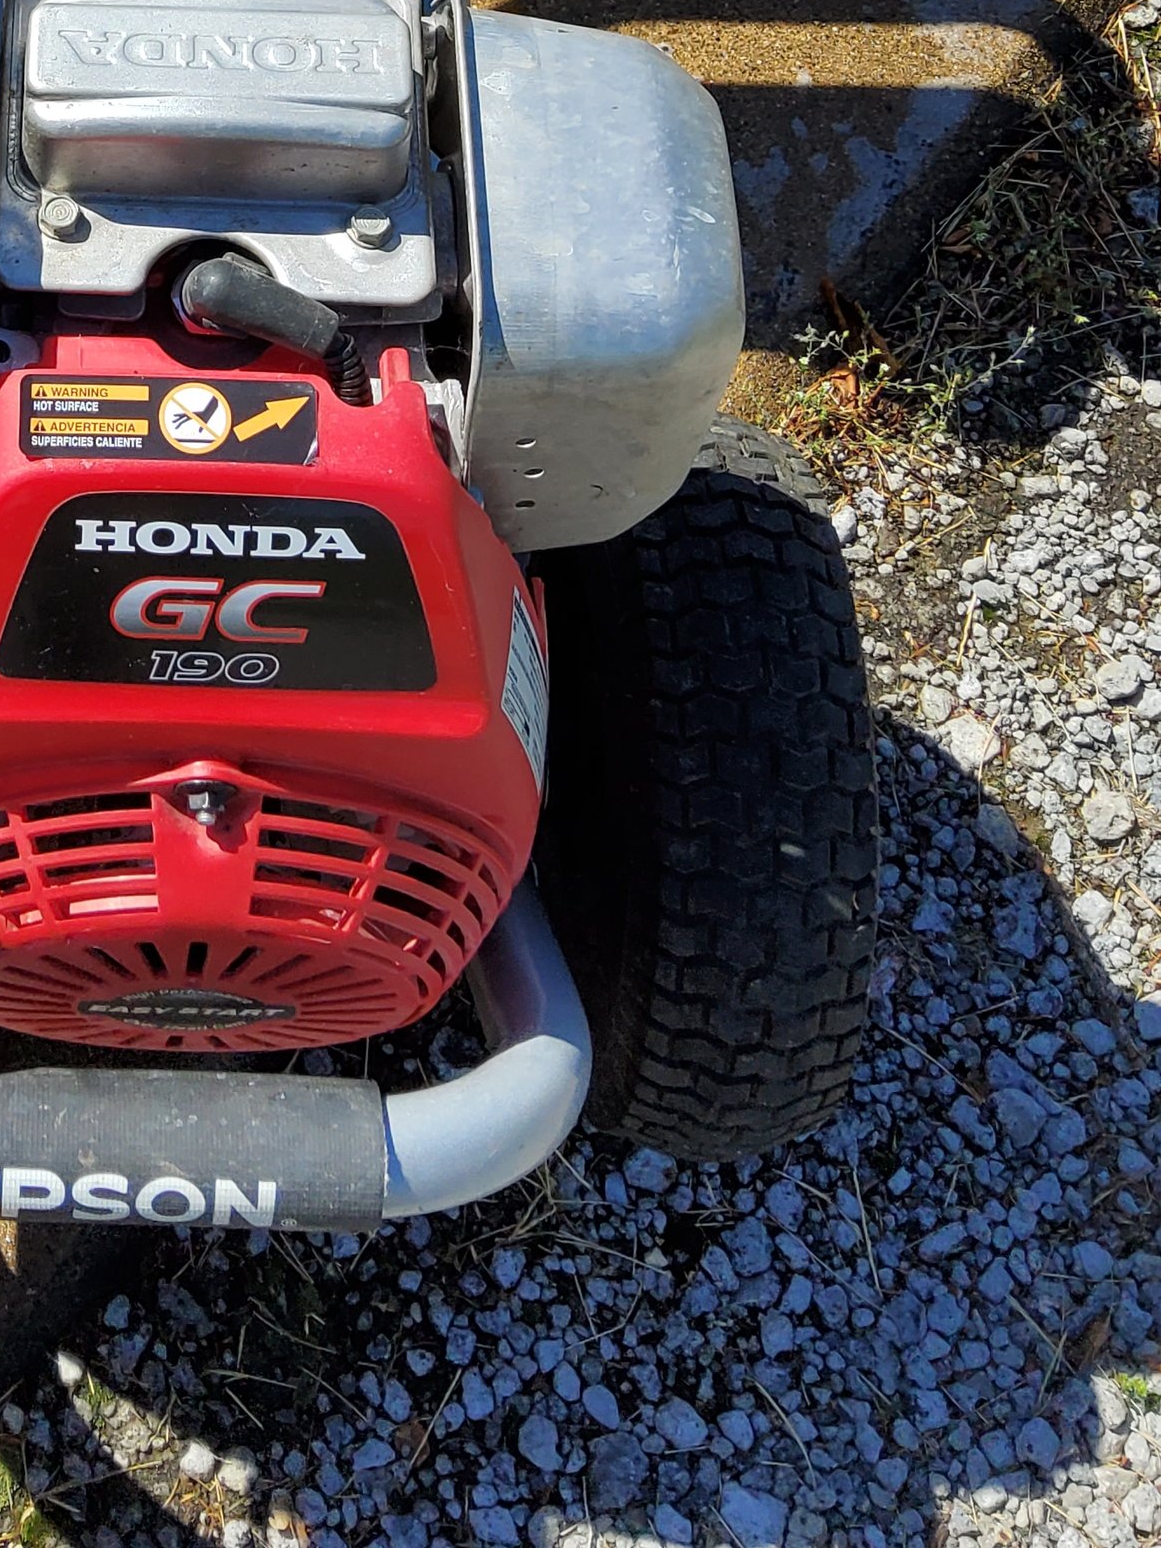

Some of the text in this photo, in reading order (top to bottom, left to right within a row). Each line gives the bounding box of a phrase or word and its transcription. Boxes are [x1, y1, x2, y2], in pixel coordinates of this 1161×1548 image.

[58, 29, 383, 75] HONDA
[50, 387, 109, 399] WARNING
[33, 400, 99, 413] HOT SURFACE
[49, 421, 136, 433] ADVERTENCIA
[31, 436, 143, 449] SUPERFICIES CALIENTE
[74, 518, 366, 560] HONDA
[109, 575, 327, 644] GC
[150, 649, 280, 684] 190
